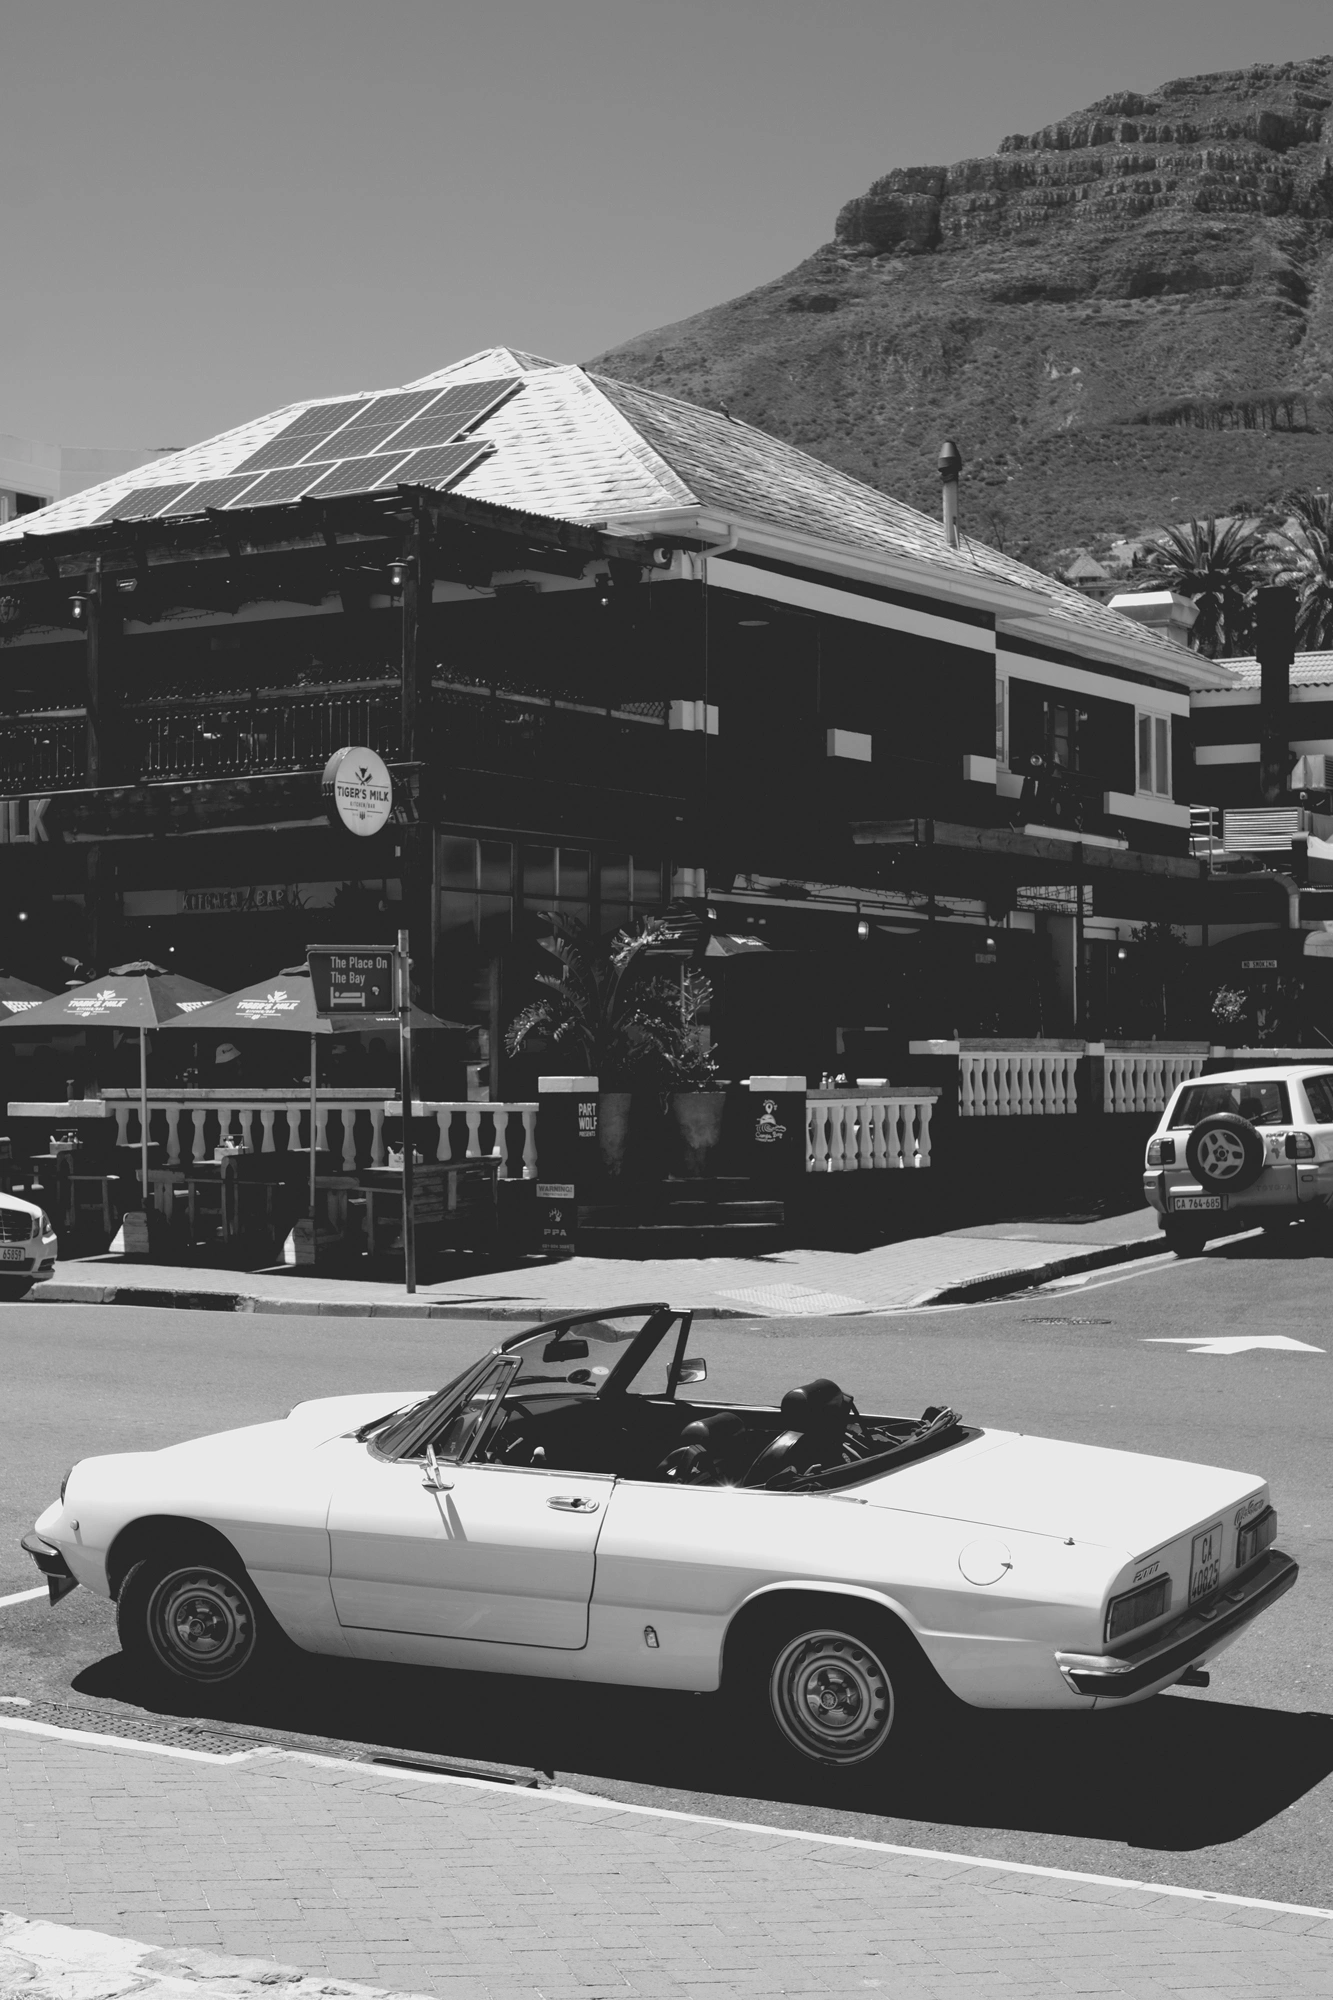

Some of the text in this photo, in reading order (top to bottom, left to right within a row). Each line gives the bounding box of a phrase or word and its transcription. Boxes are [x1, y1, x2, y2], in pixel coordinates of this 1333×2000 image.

[337, 786, 389, 802] TIGER'S MILK
[330, 956, 388, 969] The Place On
[330, 971, 365, 987] The Bay
[578, 1102, 597, 1116] PART
[578, 1116, 598, 1130] WOLF
[538, 1185, 573, 1193] WARNING!
[1256, 1183, 1292, 1192] TOYOTA
[1176, 1198, 1220, 1209] CA 764-685
[543, 1228, 567, 1236] PPA
[3, 1249, 21, 1260] 65859
[1202, 1534, 1212, 1564] CA
[1192, 1558, 1219, 1598] 40825
